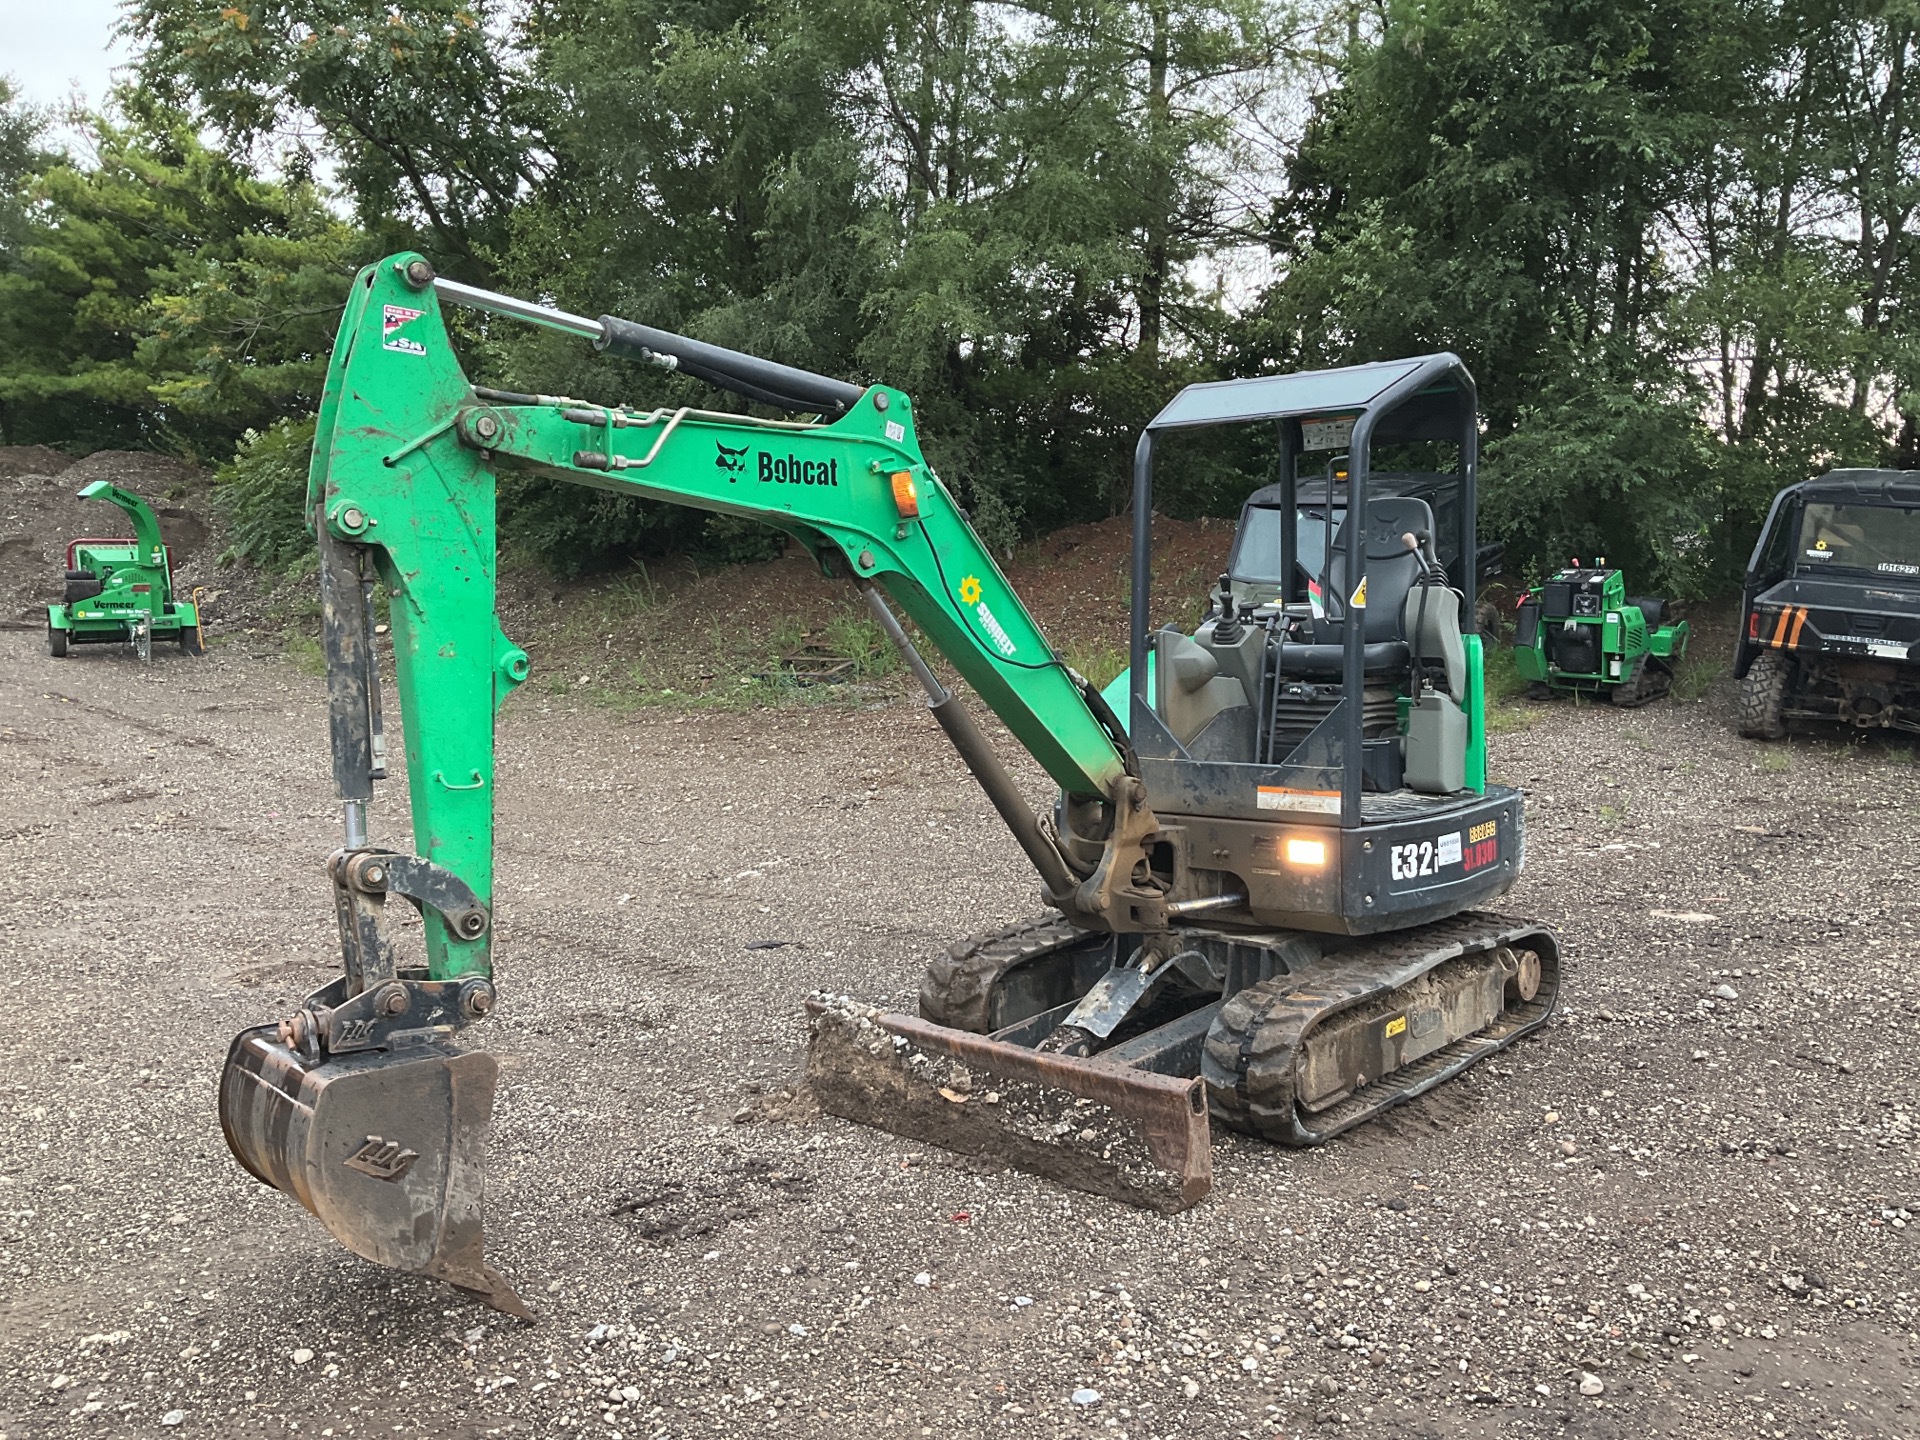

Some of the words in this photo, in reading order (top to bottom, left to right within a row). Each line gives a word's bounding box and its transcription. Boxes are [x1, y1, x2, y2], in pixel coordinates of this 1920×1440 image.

[757, 450, 839, 488] Bobcat
[112, 488, 138, 508] Vermeer
[93, 600, 135, 610] Vermeer
[976, 601, 1017, 656] SUNBELT
